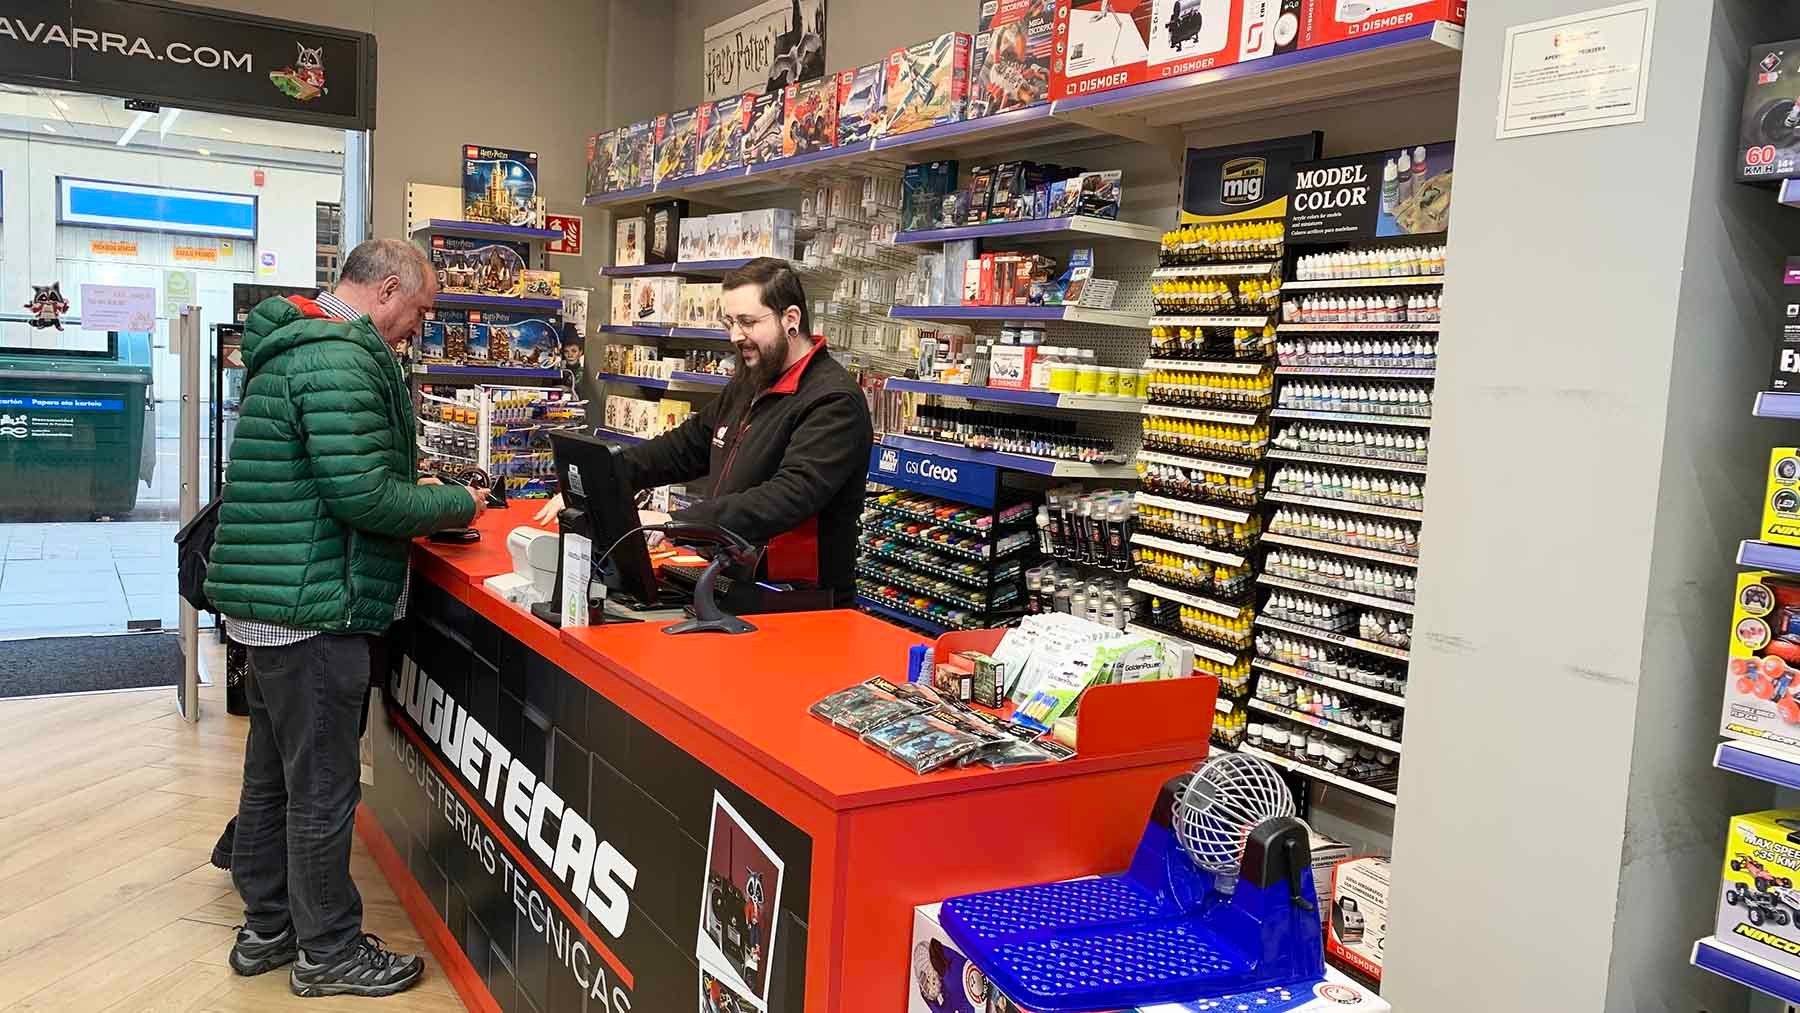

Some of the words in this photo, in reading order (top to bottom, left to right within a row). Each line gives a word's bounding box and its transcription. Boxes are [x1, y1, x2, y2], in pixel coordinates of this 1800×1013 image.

[1362, 12, 1414, 32] DISMOER
[706, 44, 736, 97] Harry
[735, 31, 770, 91] Potter
[1172, 57, 1215, 75] DISMOER
[1079, 71, 1128, 93] DISMOER
[1746, 145, 1776, 165] 60
[1223, 177, 1261, 200] mig
[1295, 164, 1368, 190] MODEL
[1294, 186, 1368, 212] COLOR
[906, 461, 919, 475] GSI
[920, 459, 959, 483] Creos
[391, 653, 638, 940] JUGUETECAS
[391, 727, 497, 875] JUGUETERIAS
[1744, 836, 1772, 850] MAX
[1753, 850, 1774, 862] +35
[1346, 951, 1380, 976] DISMOER
